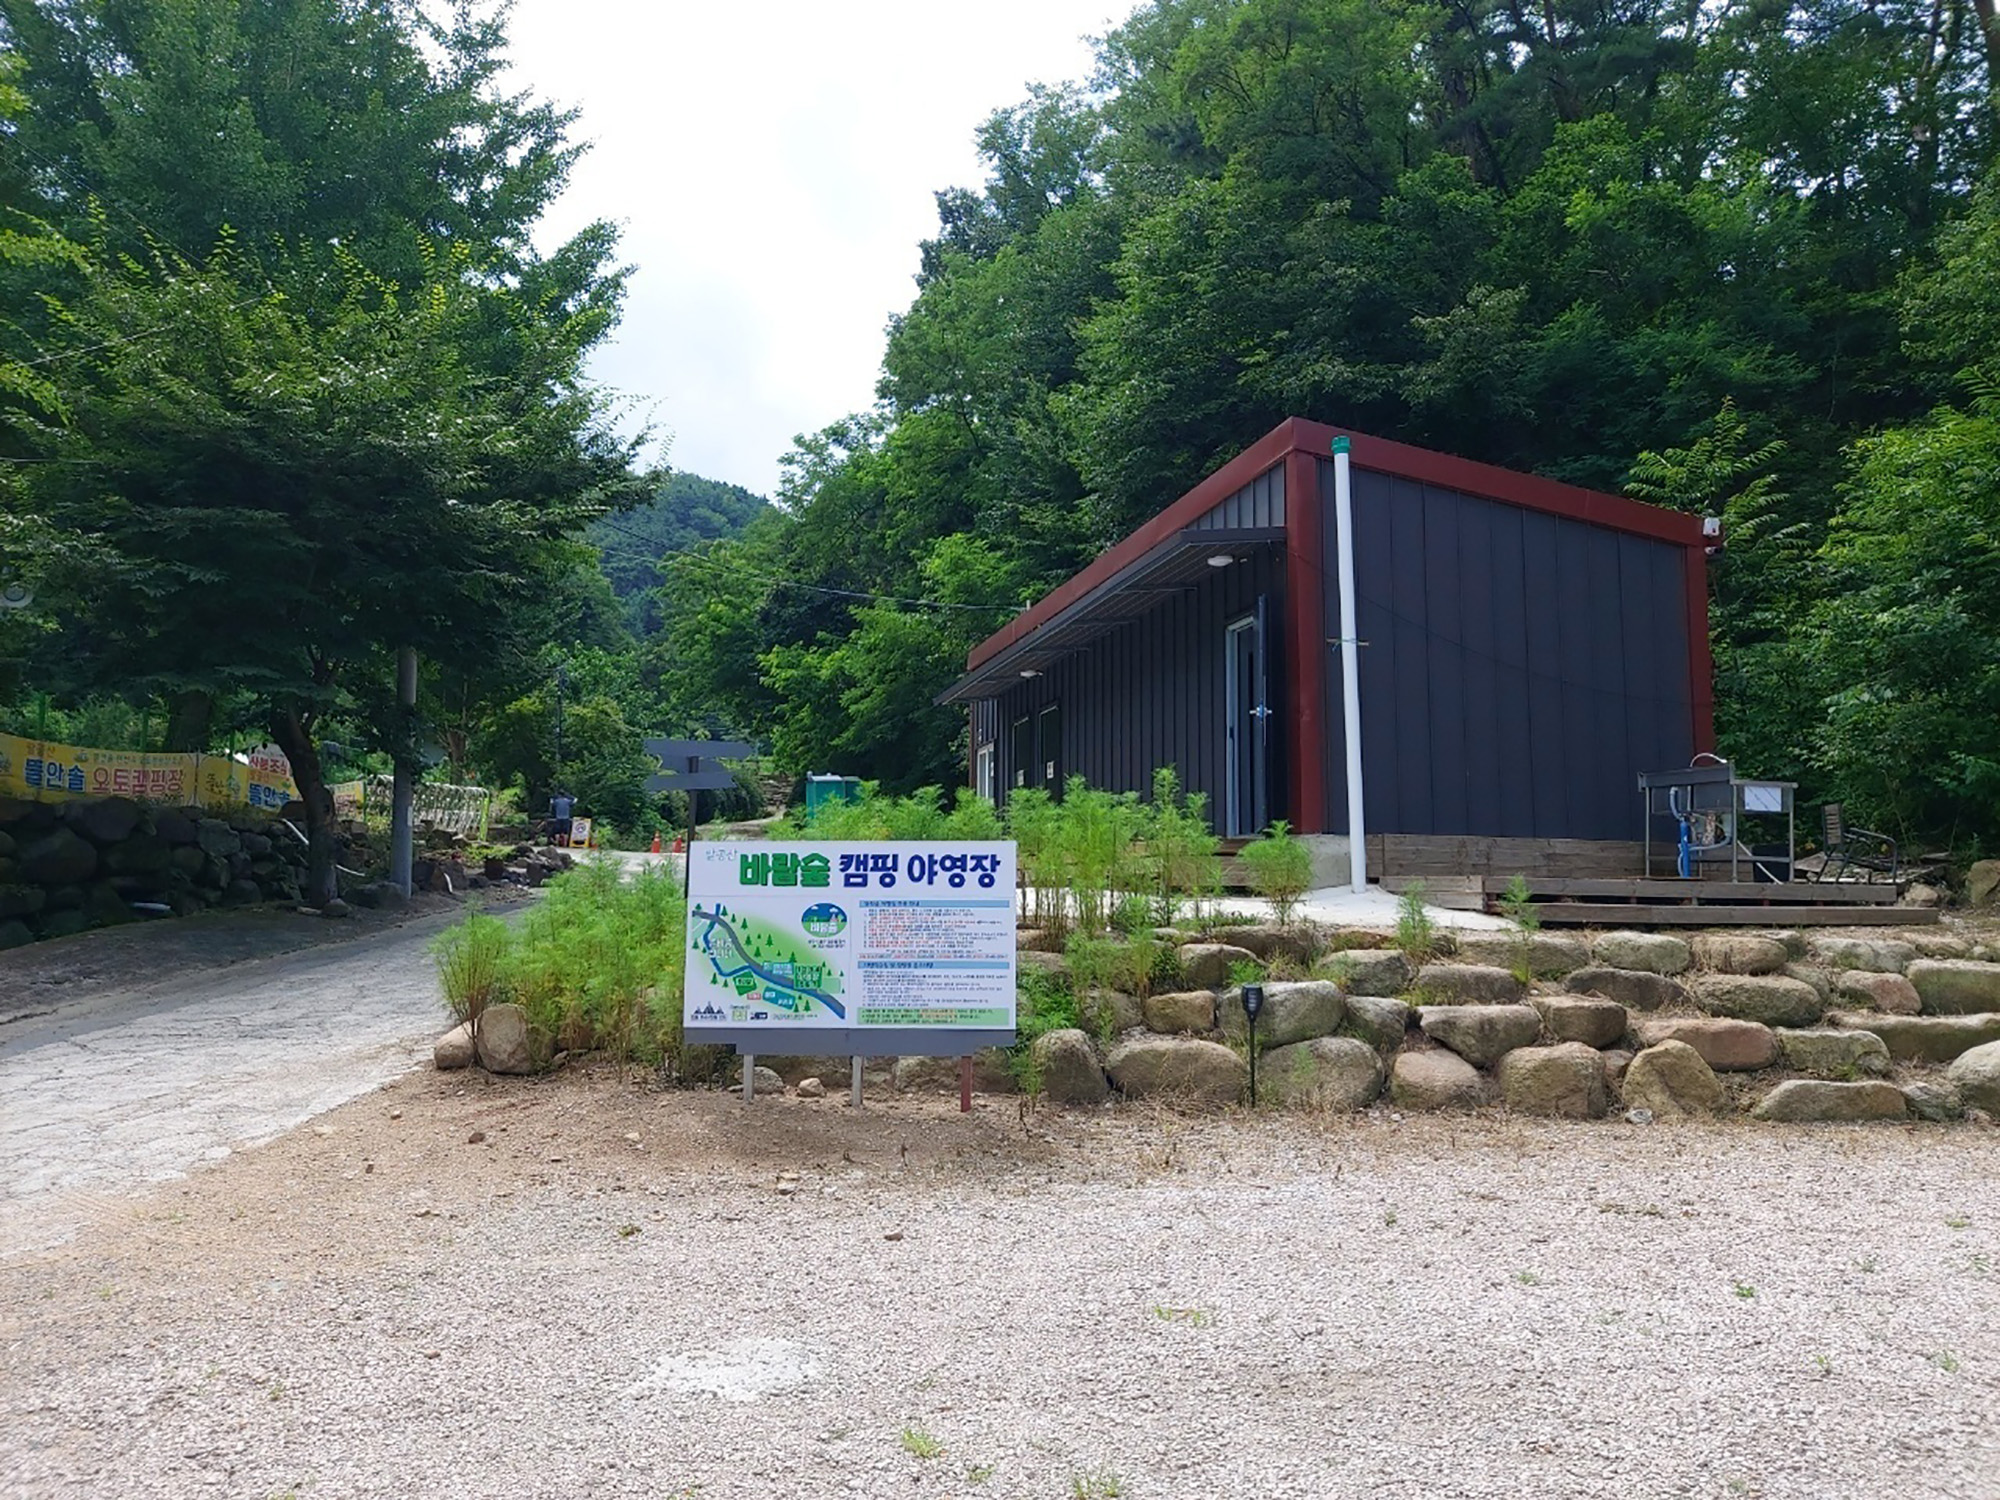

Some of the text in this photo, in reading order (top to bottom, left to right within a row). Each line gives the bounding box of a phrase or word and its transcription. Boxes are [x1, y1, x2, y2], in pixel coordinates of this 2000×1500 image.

[25, 758, 184, 796] 뜰안솔 오토캠핑장
[739, 852, 831, 887] 바람숲
[838, 853, 899, 888] 캠핑
[907, 853, 1001, 888] 야영장
